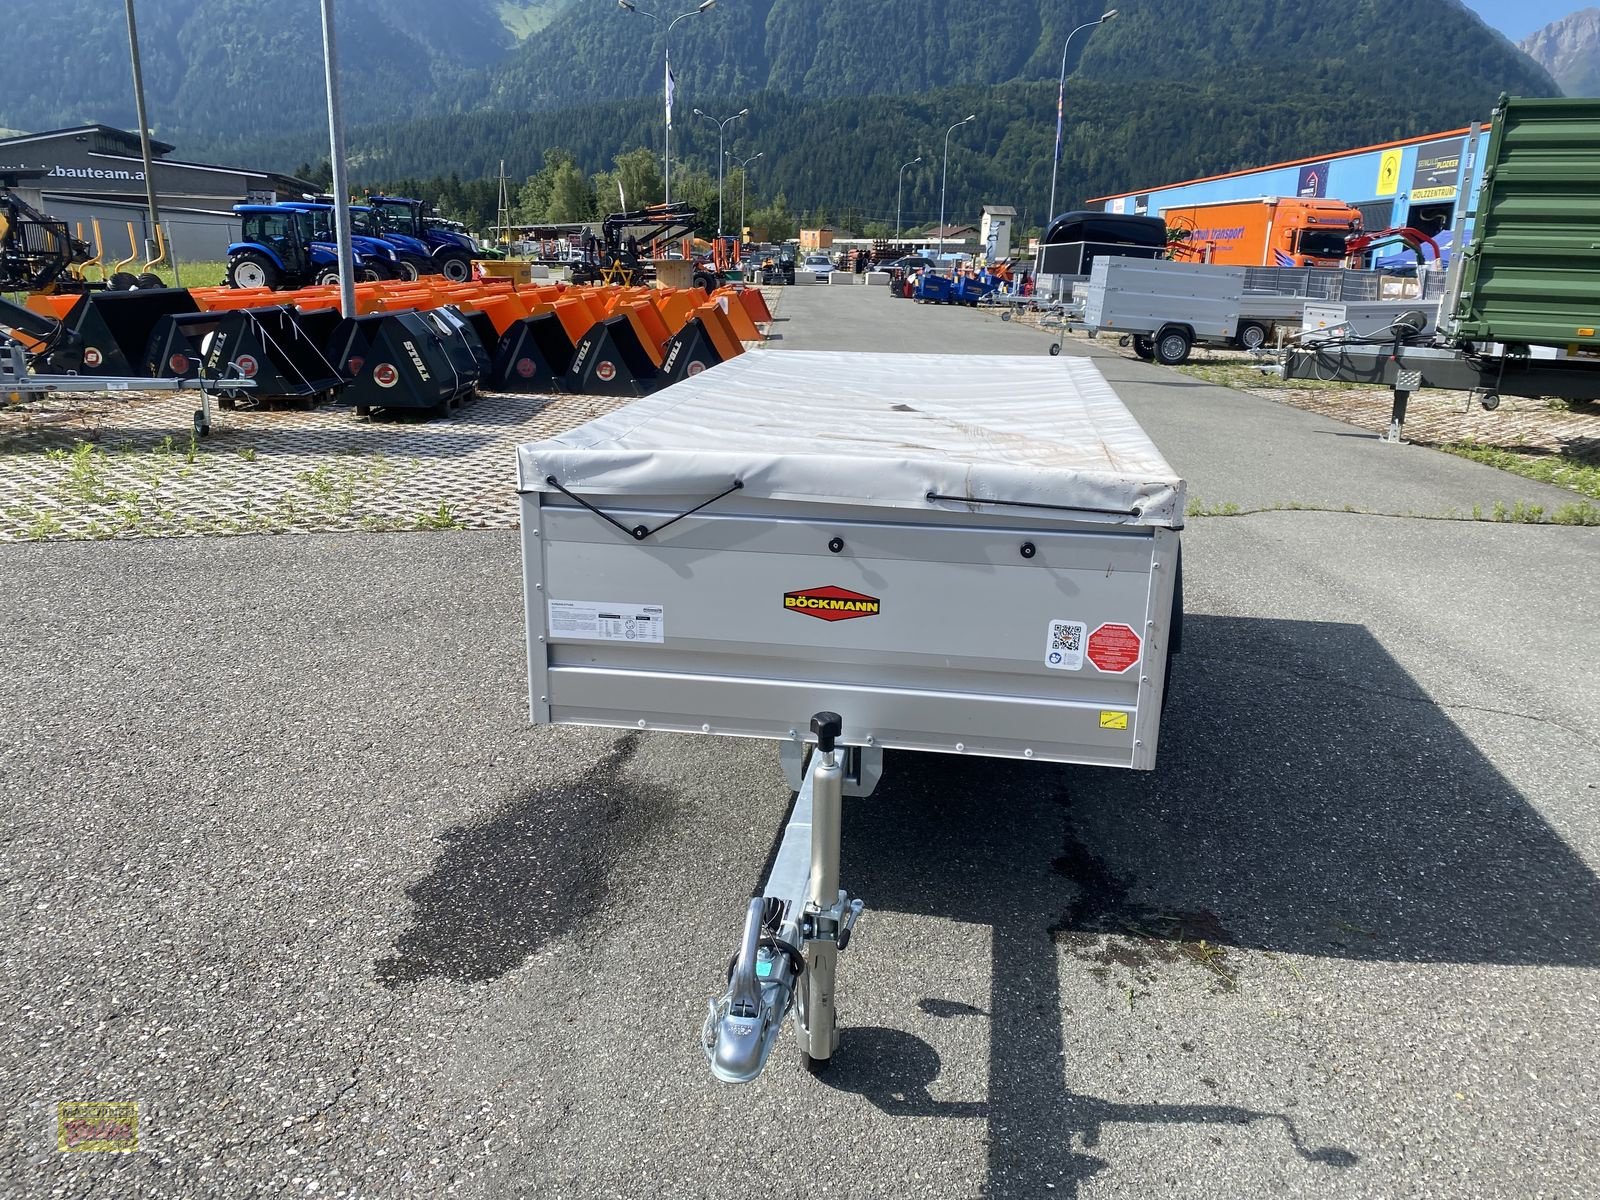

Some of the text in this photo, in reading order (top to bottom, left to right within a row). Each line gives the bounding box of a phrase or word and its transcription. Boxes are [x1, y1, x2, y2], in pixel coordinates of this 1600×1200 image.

[1412, 187, 1456, 199] HOLZZENTRUM
[1211, 226, 1245, 241] transport
[207, 331, 227, 369] STOLL
[402, 340, 431, 382] STOLL
[572, 339, 591, 374] STOLL
[663, 340, 683, 374] STOLL
[785, 596, 879, 612] BÖCKMANN
